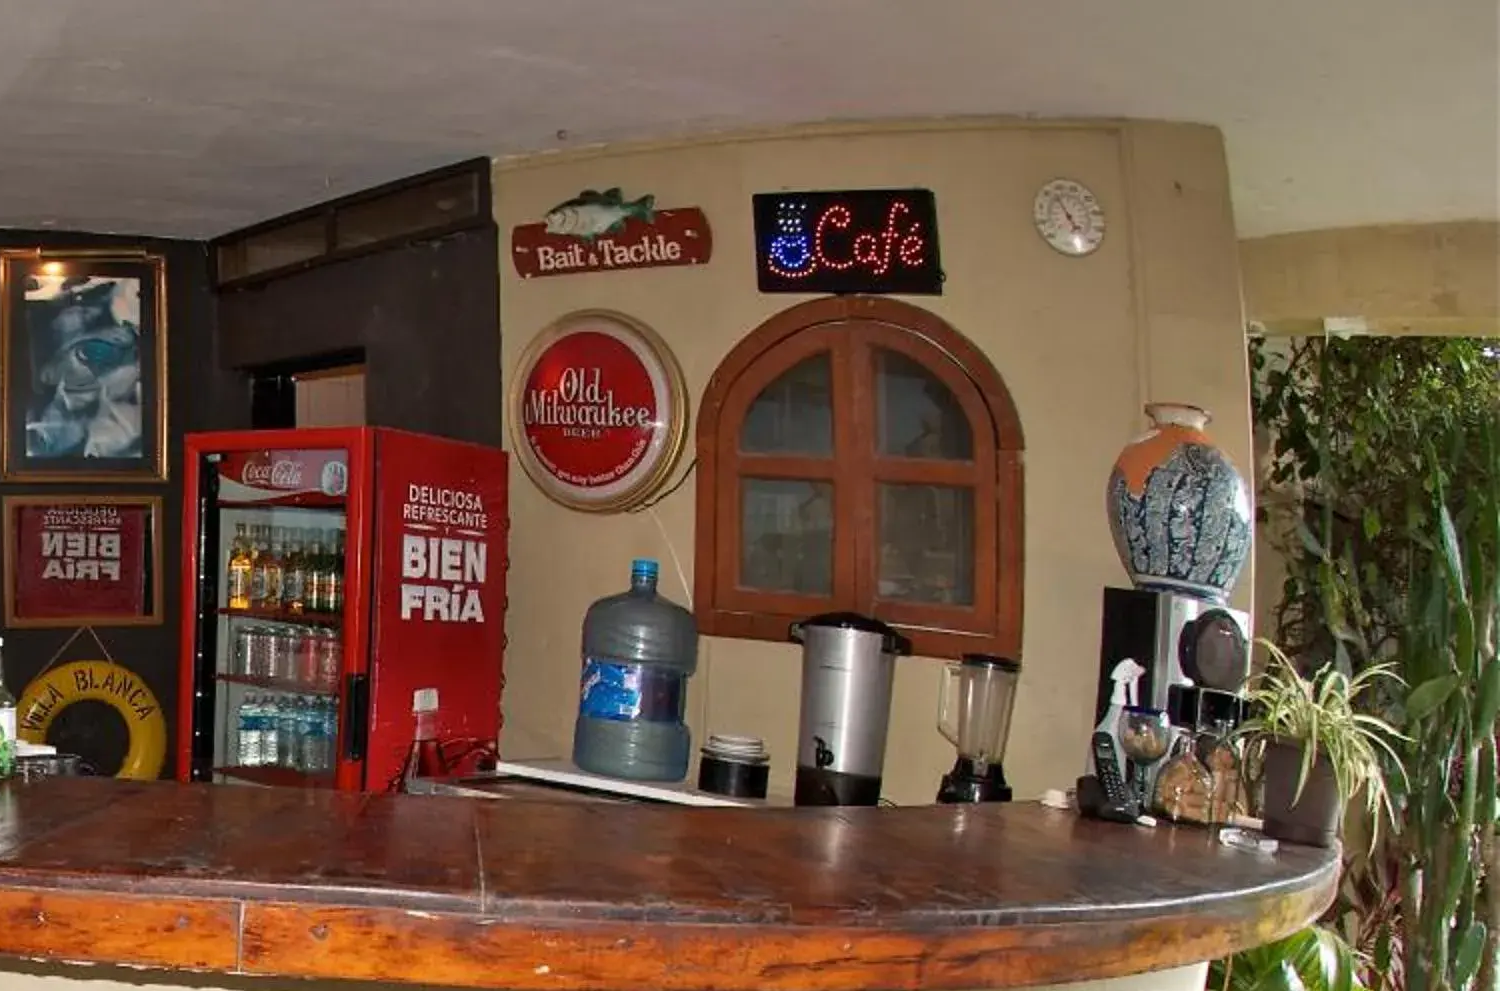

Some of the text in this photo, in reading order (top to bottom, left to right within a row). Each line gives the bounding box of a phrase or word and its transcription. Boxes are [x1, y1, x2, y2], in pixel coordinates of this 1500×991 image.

[537, 243, 585, 271] Bait
[598, 235, 681, 267] Tackle
[815, 202, 924, 275] Café
[560, 367, 607, 403] Old
[525, 390, 650, 427] Milwaukee
[563, 428, 602, 438] BEER
[408, 484, 483, 512] DELICIOSA
[403, 504, 488, 529] REFRESCANTE
[402, 533, 488, 583] BIEN
[74, 669, 155, 722] BLANCA
